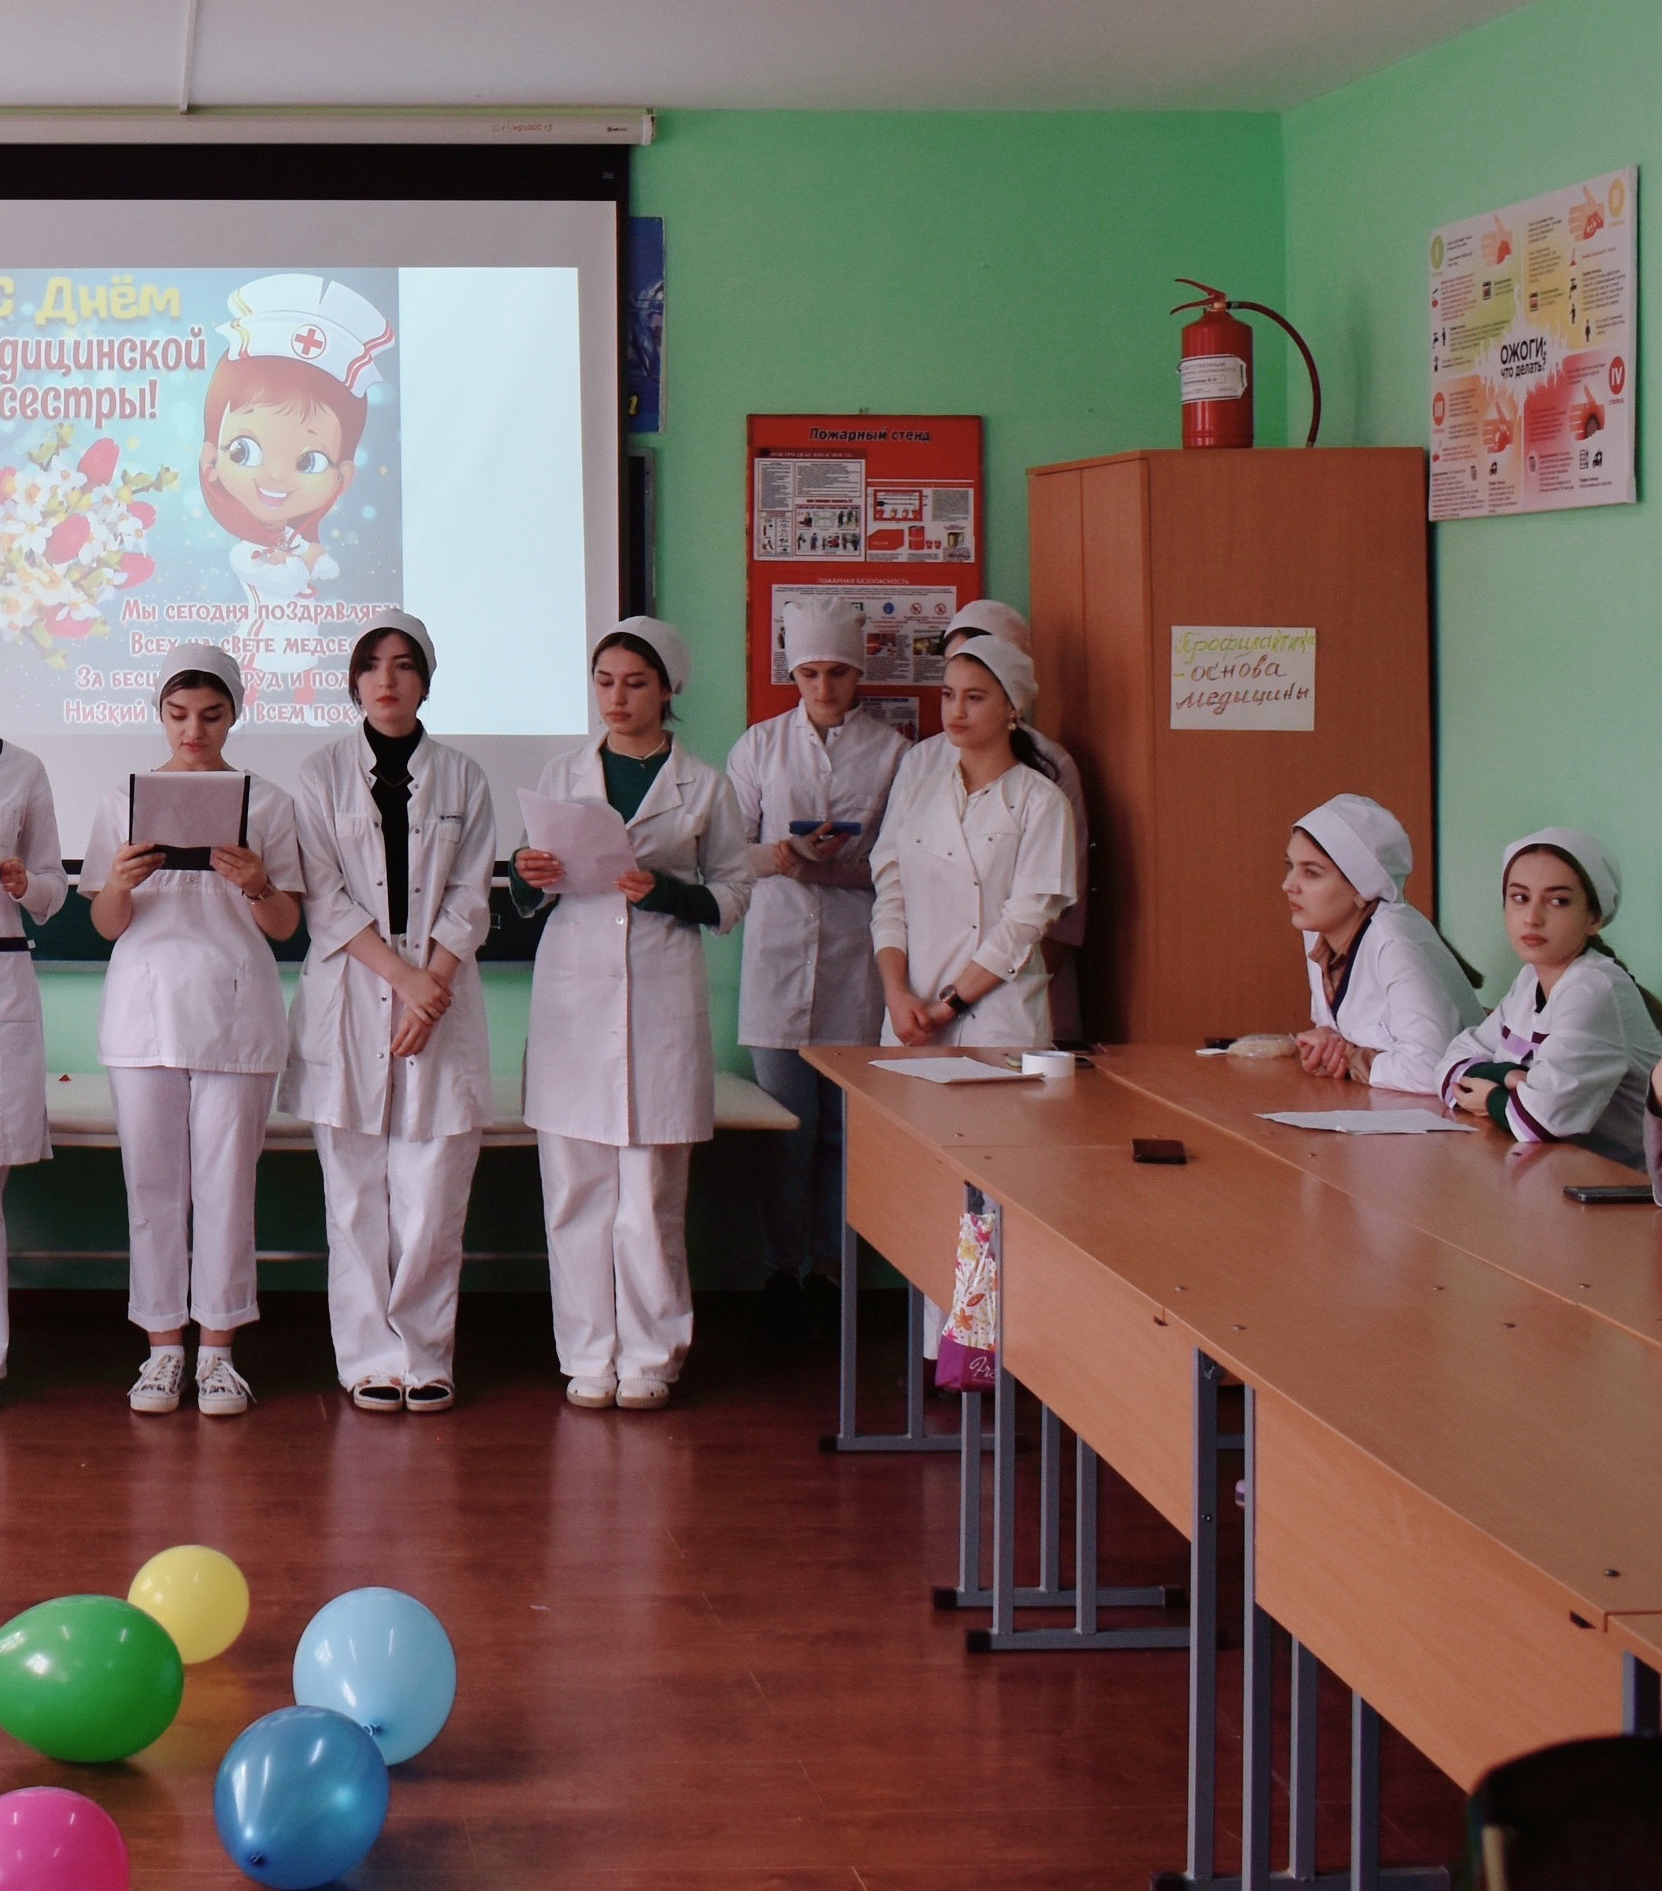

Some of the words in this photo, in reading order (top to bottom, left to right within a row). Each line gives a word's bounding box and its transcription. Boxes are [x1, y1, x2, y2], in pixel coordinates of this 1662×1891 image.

[34, 274, 181, 327] Днём
[1500, 337, 1547, 365] ОЖОГИ:
[1501, 367, 1513, 380] что
[1514, 358, 1547, 379] делать?
[1611, 366, 1623, 387] IV
[810, 426, 888, 442] Пожарный
[891, 429, 931, 443] стенд
[1190, 654, 1287, 682] основа
[1176, 682, 1310, 716] медицины
